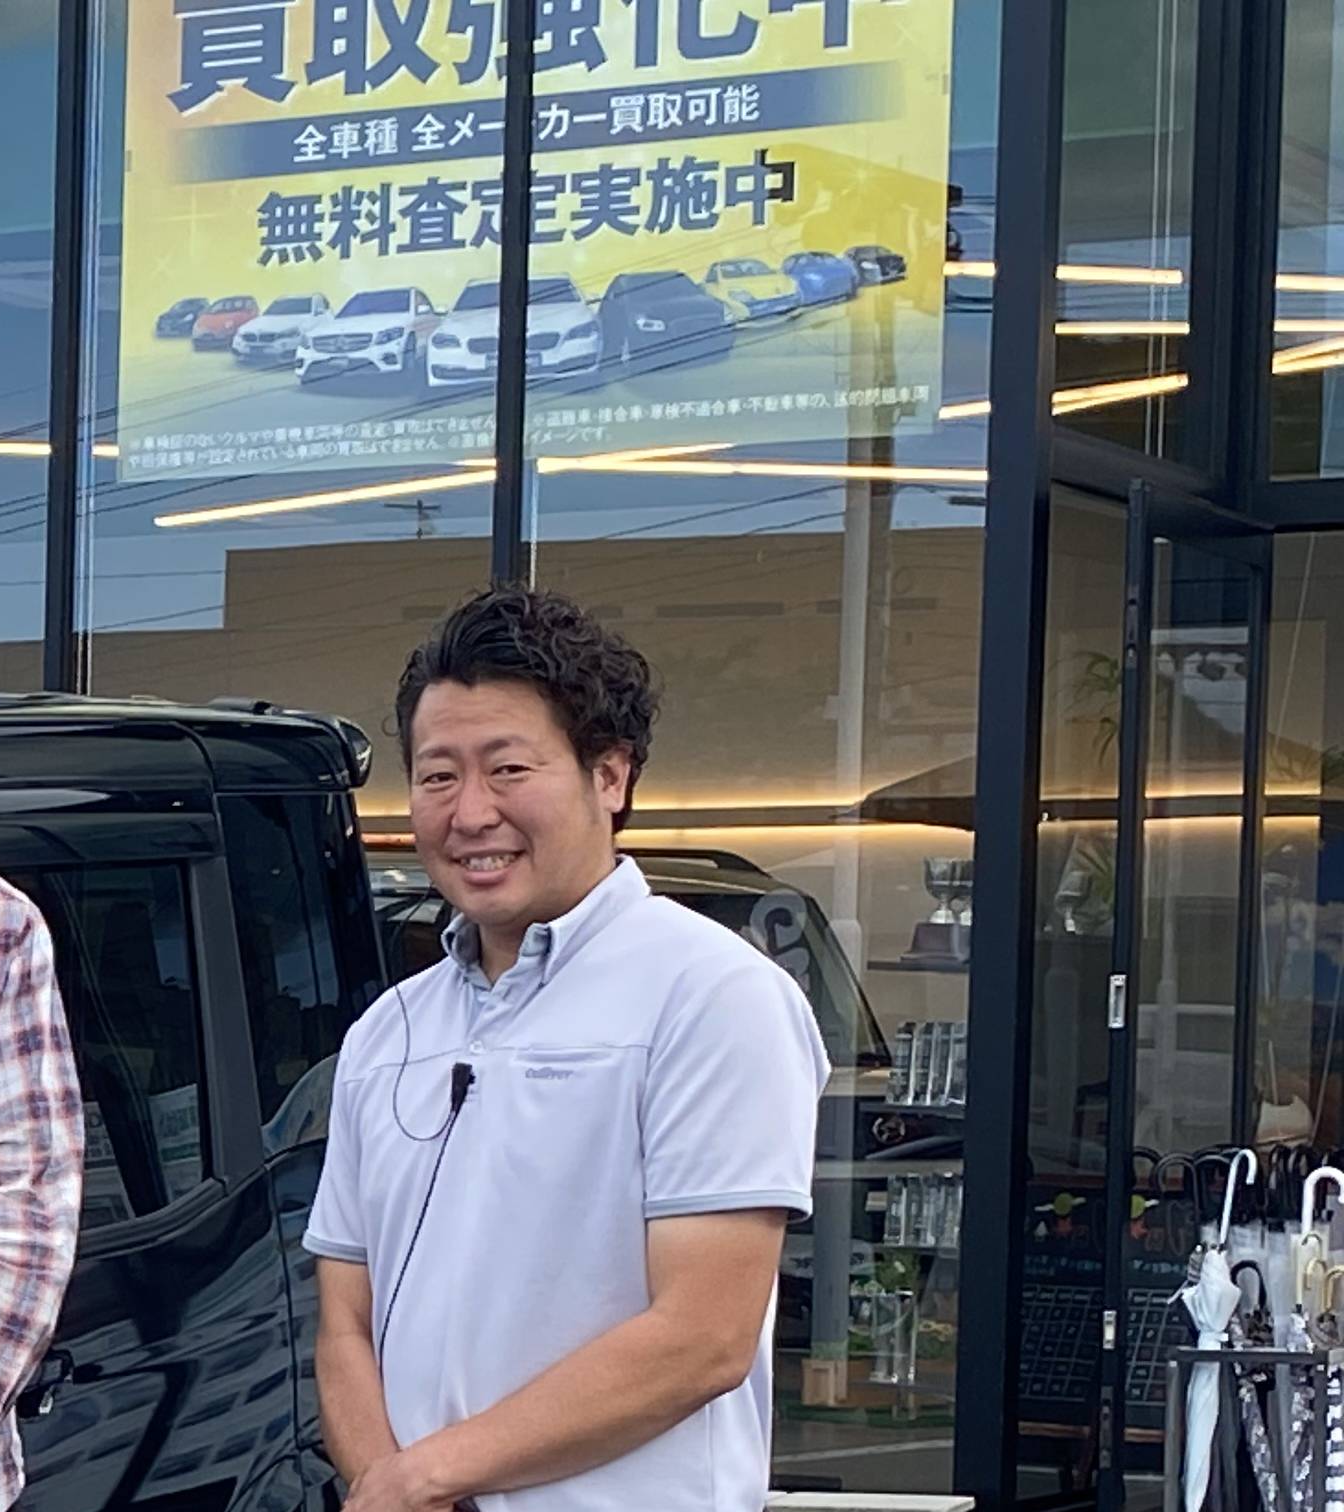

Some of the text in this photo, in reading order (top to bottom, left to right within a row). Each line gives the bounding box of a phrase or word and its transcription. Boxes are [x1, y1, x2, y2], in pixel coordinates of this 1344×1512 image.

[293, 84, 760, 162] 全車種 全メーカー買取可能
[257, 148, 795, 267] 無料査定実施中
